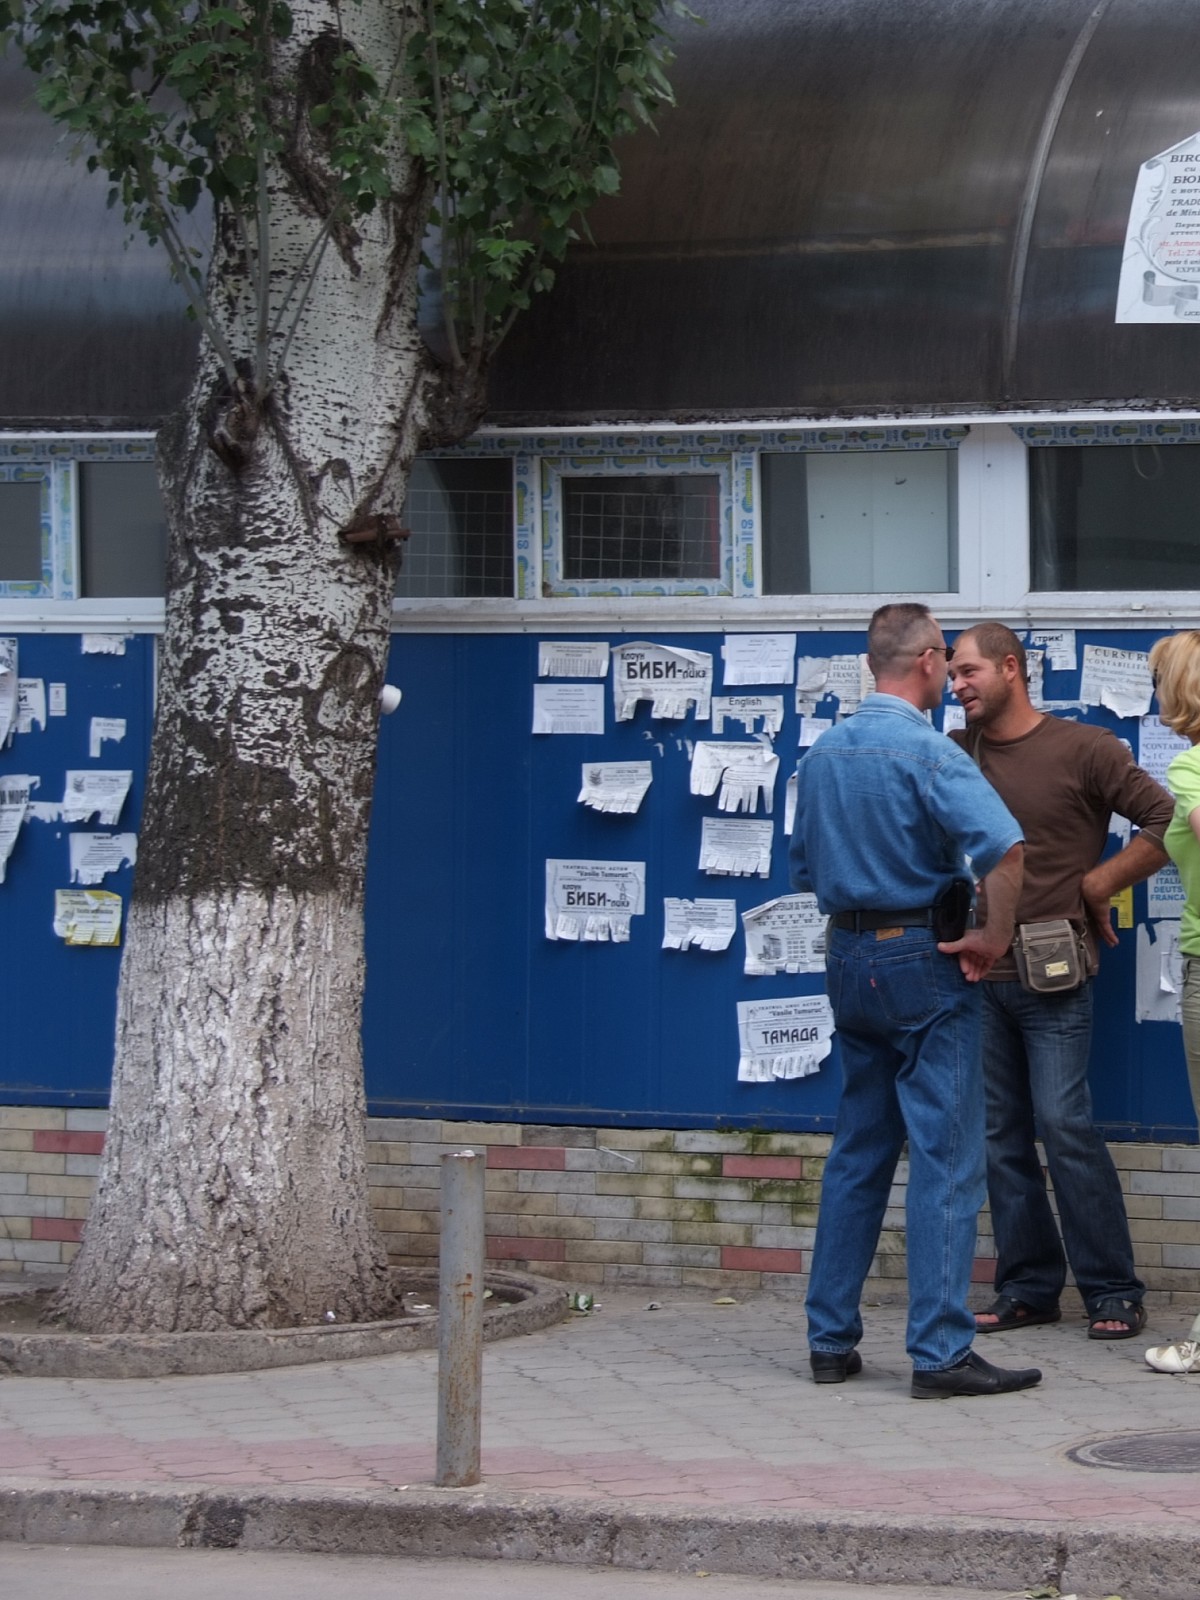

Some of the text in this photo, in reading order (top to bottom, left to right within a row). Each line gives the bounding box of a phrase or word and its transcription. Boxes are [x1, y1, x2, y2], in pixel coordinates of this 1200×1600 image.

[1166, 209, 1178, 217] de
[1035, 634, 1063, 642] трик!
[729, 697, 762, 708] English
[761, 1027, 819, 1045] ТАМАДА
